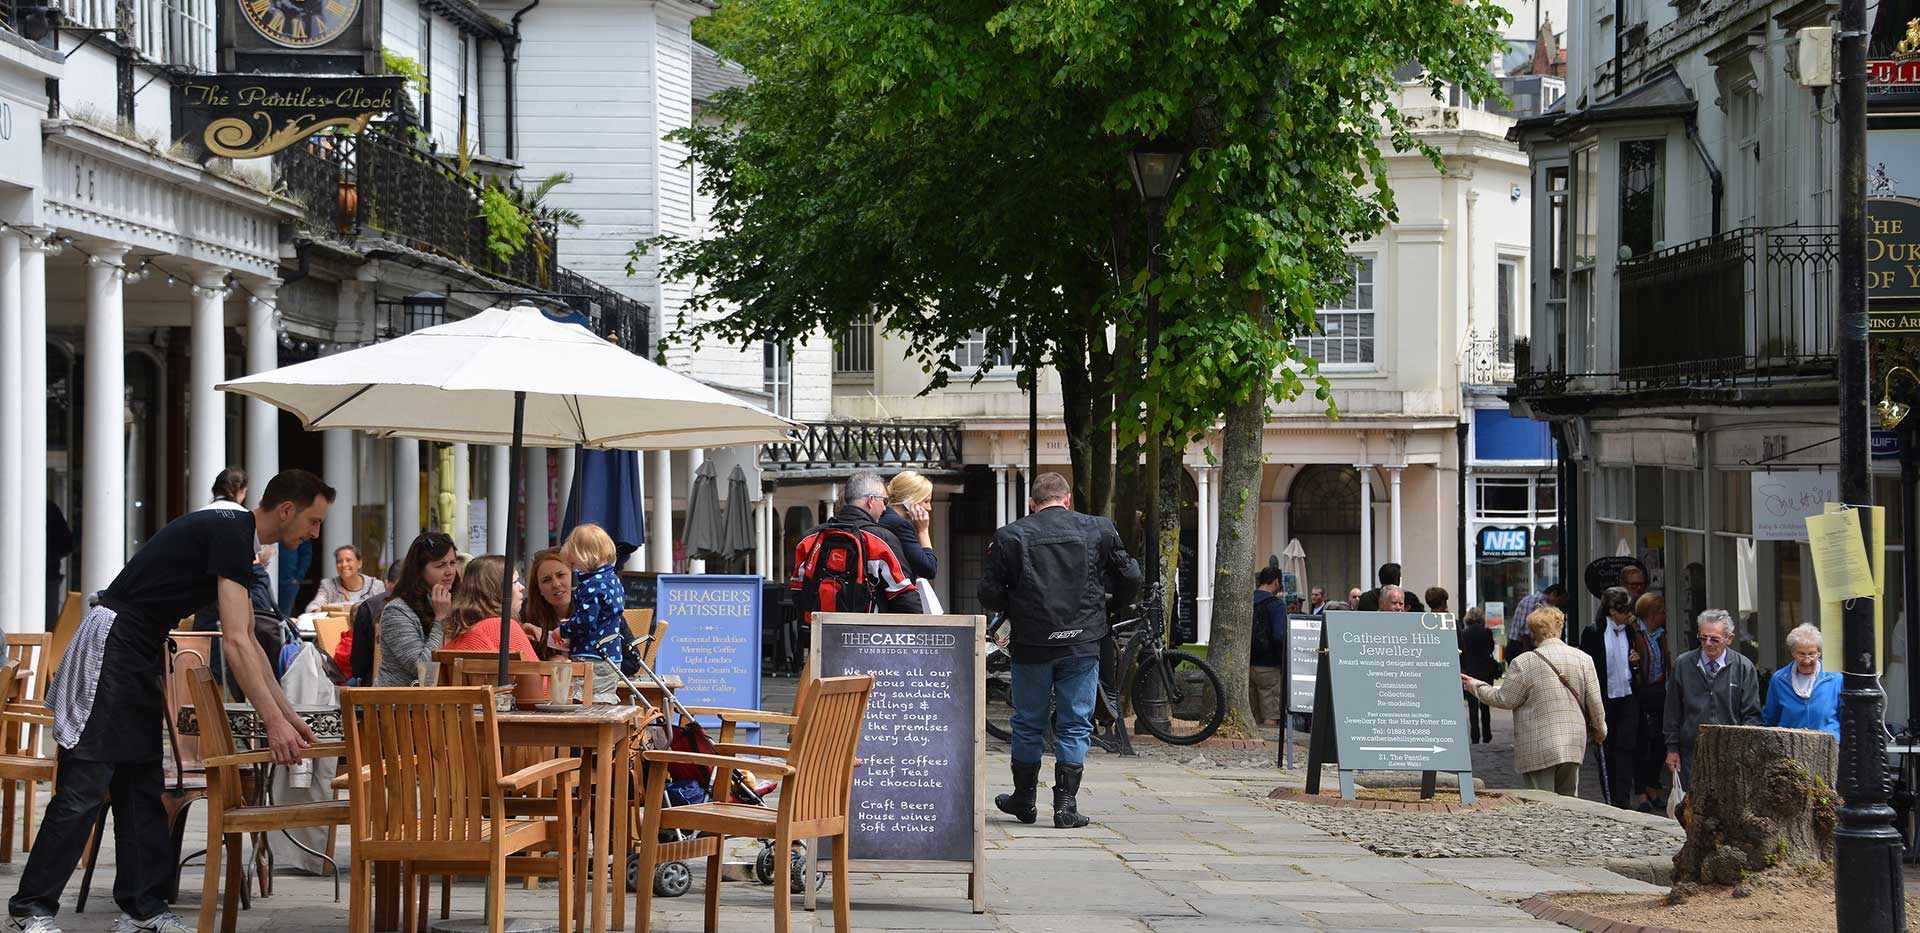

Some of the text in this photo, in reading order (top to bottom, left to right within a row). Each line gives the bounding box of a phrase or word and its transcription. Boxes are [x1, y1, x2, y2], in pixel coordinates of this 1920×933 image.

[184, 85, 392, 108] The Pantiles Clock
[1867, 318, 1896, 328] NING
[1871, 437, 1898, 447] WIFT
[1485, 531, 1525, 550] NHS
[669, 589, 751, 602] SHRAGER'S
[1421, 612, 1457, 630] CH
[1048, 629, 1083, 640] RST
[1342, 632, 1440, 645] Catherine Hills
[1359, 645, 1423, 657] Jewellery
[1385, 660, 1415, 668] designer
[844, 667, 861, 676] We
[867, 667, 900, 677] make
[906, 667, 924, 676] all
[1366, 669, 1398, 678] Jewellery
[911, 679, 950, 688] cakes,
[892, 690, 951, 700] sandwich
[920, 702, 929, 710] &
[863, 711, 938, 725] inter soups
[1344, 717, 1376, 726] Jewellery
[1400, 718, 1419, 726] Harry
[868, 722, 948, 734] the premises
[864, 733, 930, 746] every day.
[901, 755, 949, 766] coffees
[868, 767, 929, 778] Leaf Teas
[854, 778, 943, 788] Hot chocolate
[861, 799, 935, 810] Craft Beers
[858, 812, 937, 821] House wines
[860, 822, 935, 833] Soft drinks
